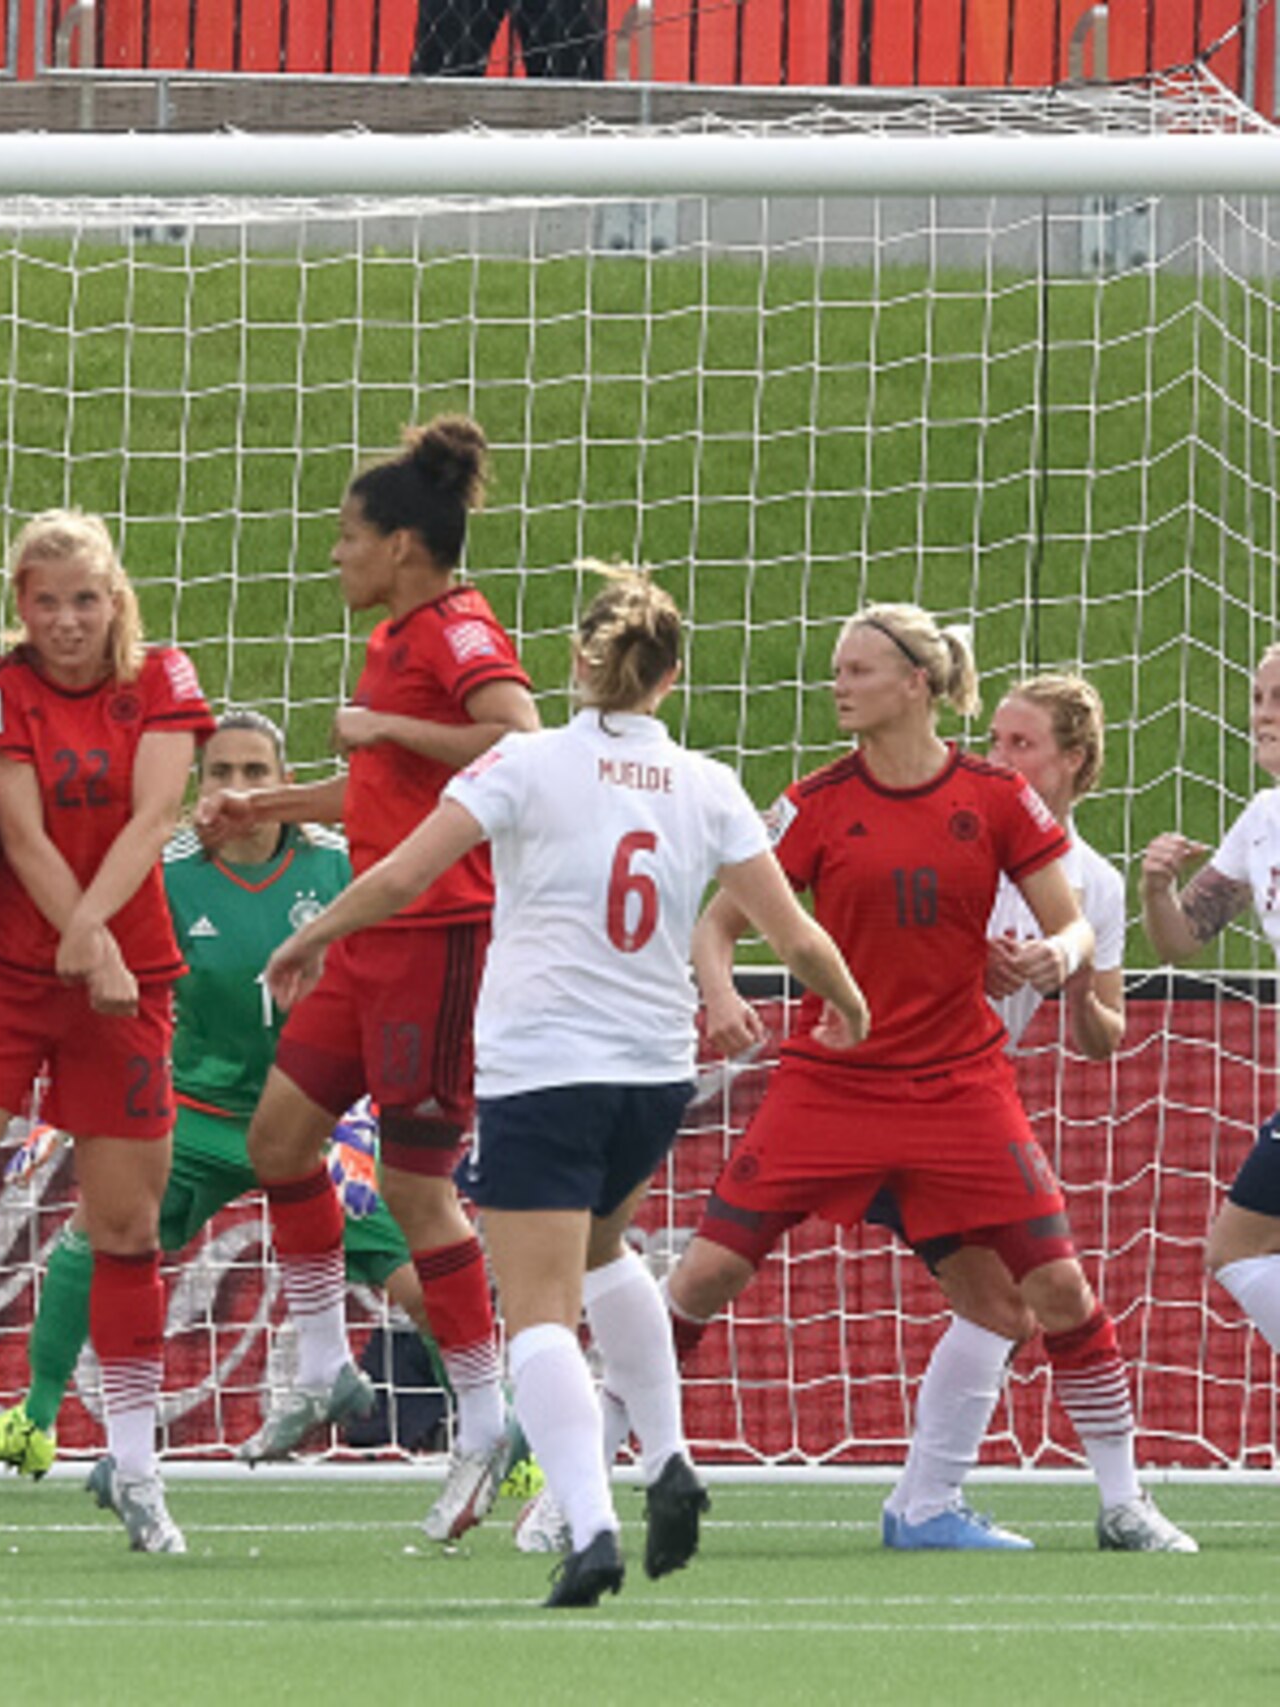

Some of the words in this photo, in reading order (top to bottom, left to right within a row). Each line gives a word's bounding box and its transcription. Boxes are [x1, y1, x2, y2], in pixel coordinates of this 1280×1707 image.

[54, 748, 110, 807] 22
[598, 758, 673, 794] MJELDE
[606, 830, 658, 953] 6
[891, 867, 938, 928] 18
[382, 1022, 421, 1086] 13
